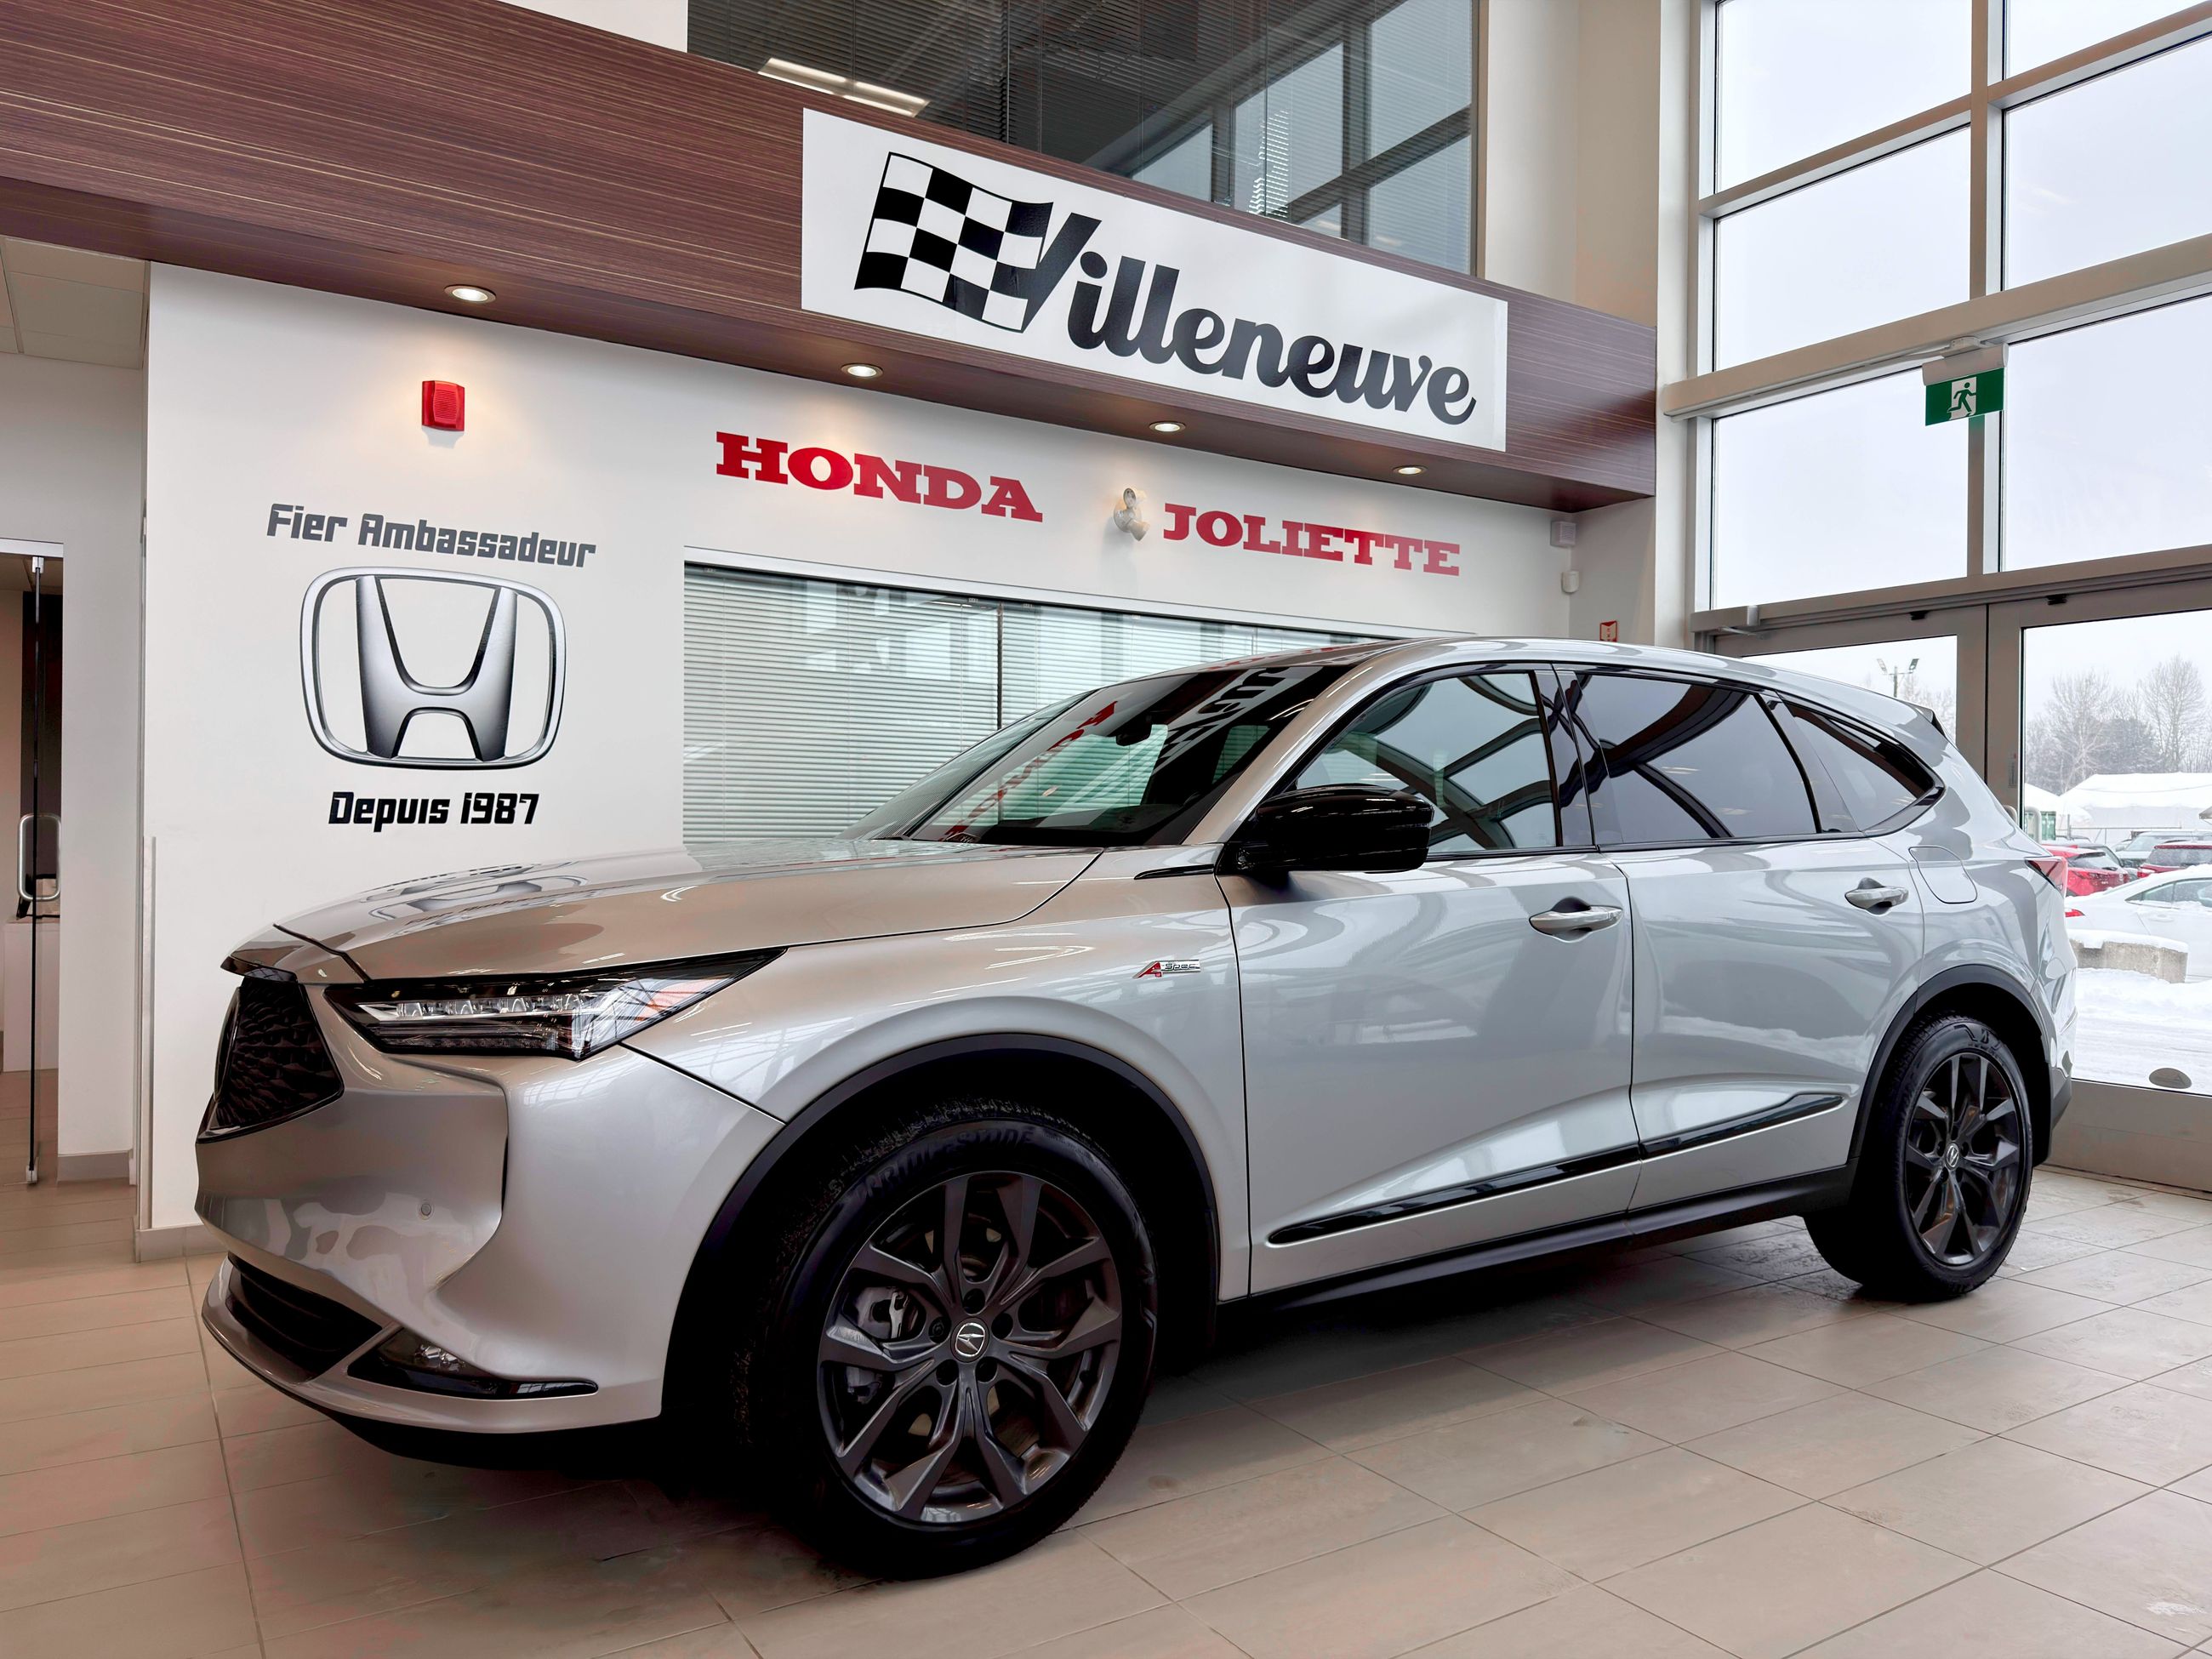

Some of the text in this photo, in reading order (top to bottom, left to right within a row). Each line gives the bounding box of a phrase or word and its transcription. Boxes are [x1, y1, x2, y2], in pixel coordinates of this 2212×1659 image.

[1004, 201, 1477, 425] Villeneuve
[266, 503, 597, 568] Fier Ambassadeur
[715, 431, 1459, 574] HONDA JOLIETTE
[328, 791, 540, 833] Depuis 1987
